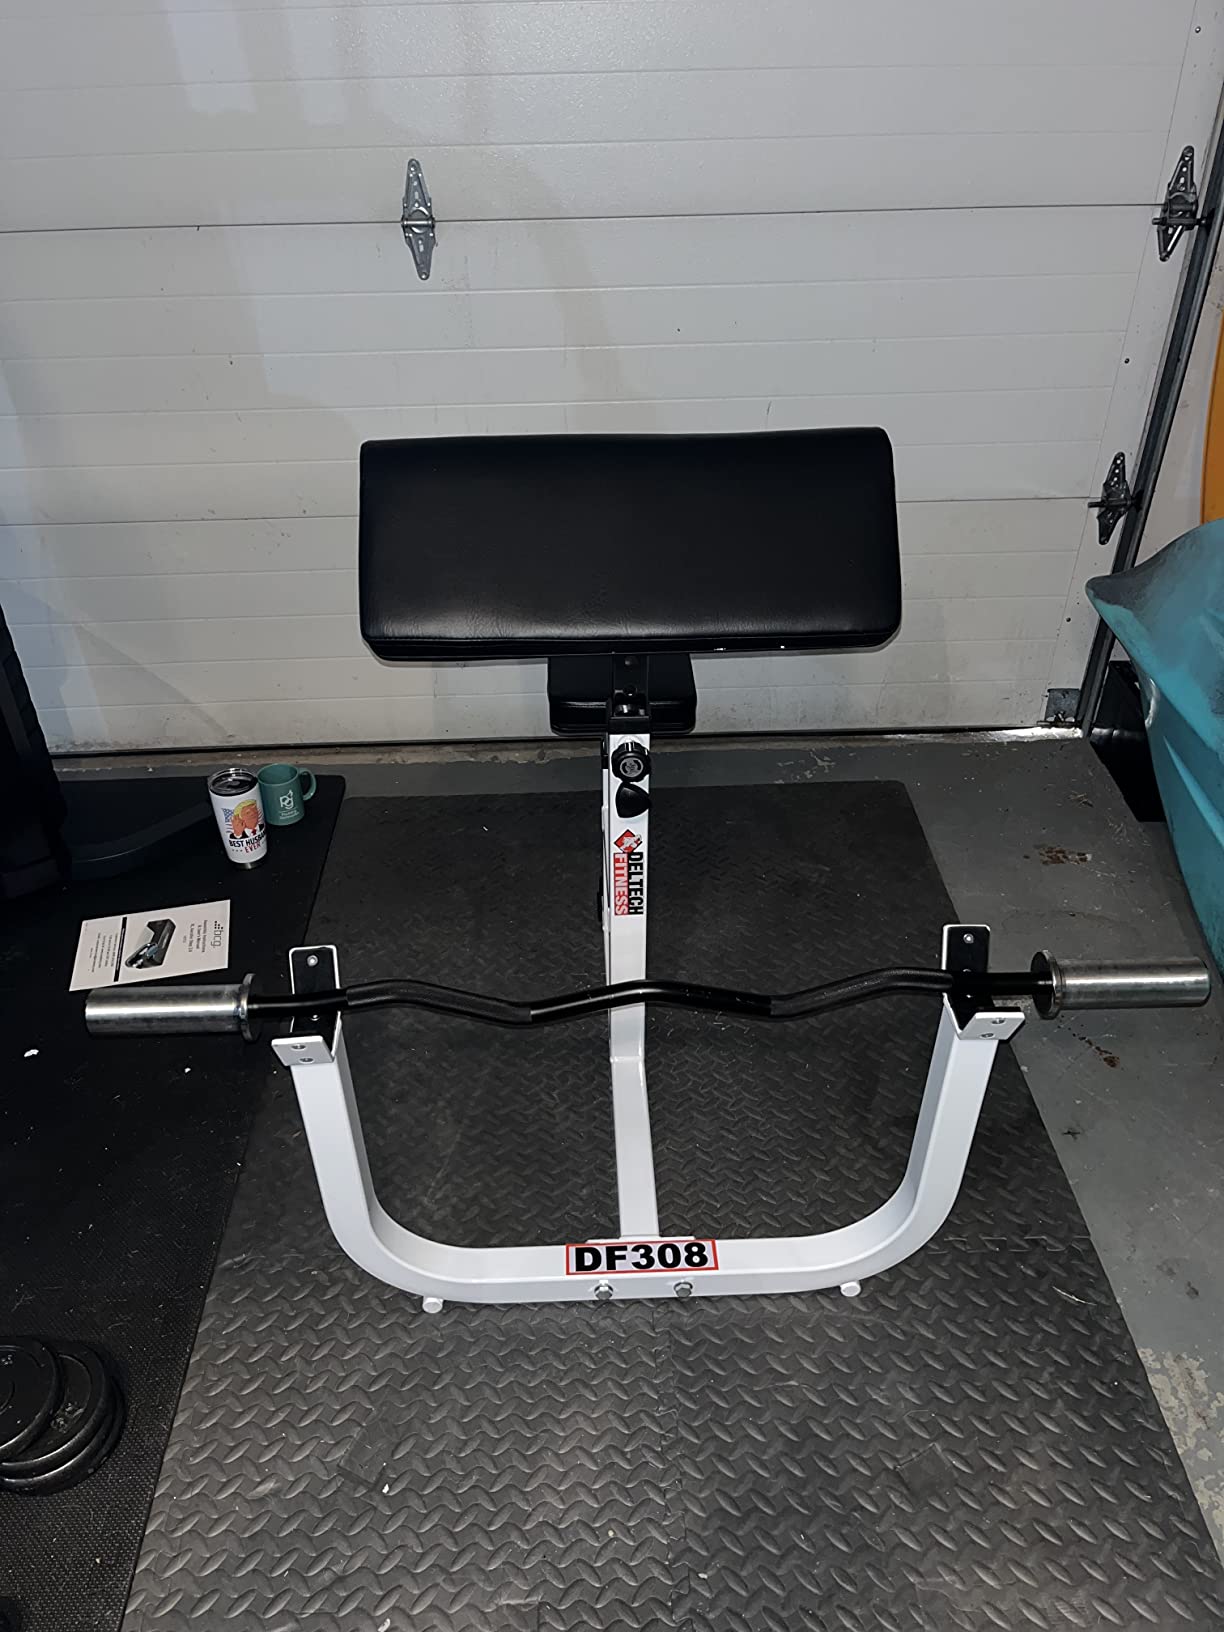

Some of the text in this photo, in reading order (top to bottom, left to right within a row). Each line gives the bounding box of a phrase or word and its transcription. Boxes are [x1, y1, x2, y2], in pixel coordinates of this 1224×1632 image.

[229, 839, 244, 848] BEST
[245, 843, 261, 853] EVER
[614, 852, 628, 916] FITNESS
[628, 852, 643, 915] DELTECH
[575, 1242, 708, 1272] DF308
